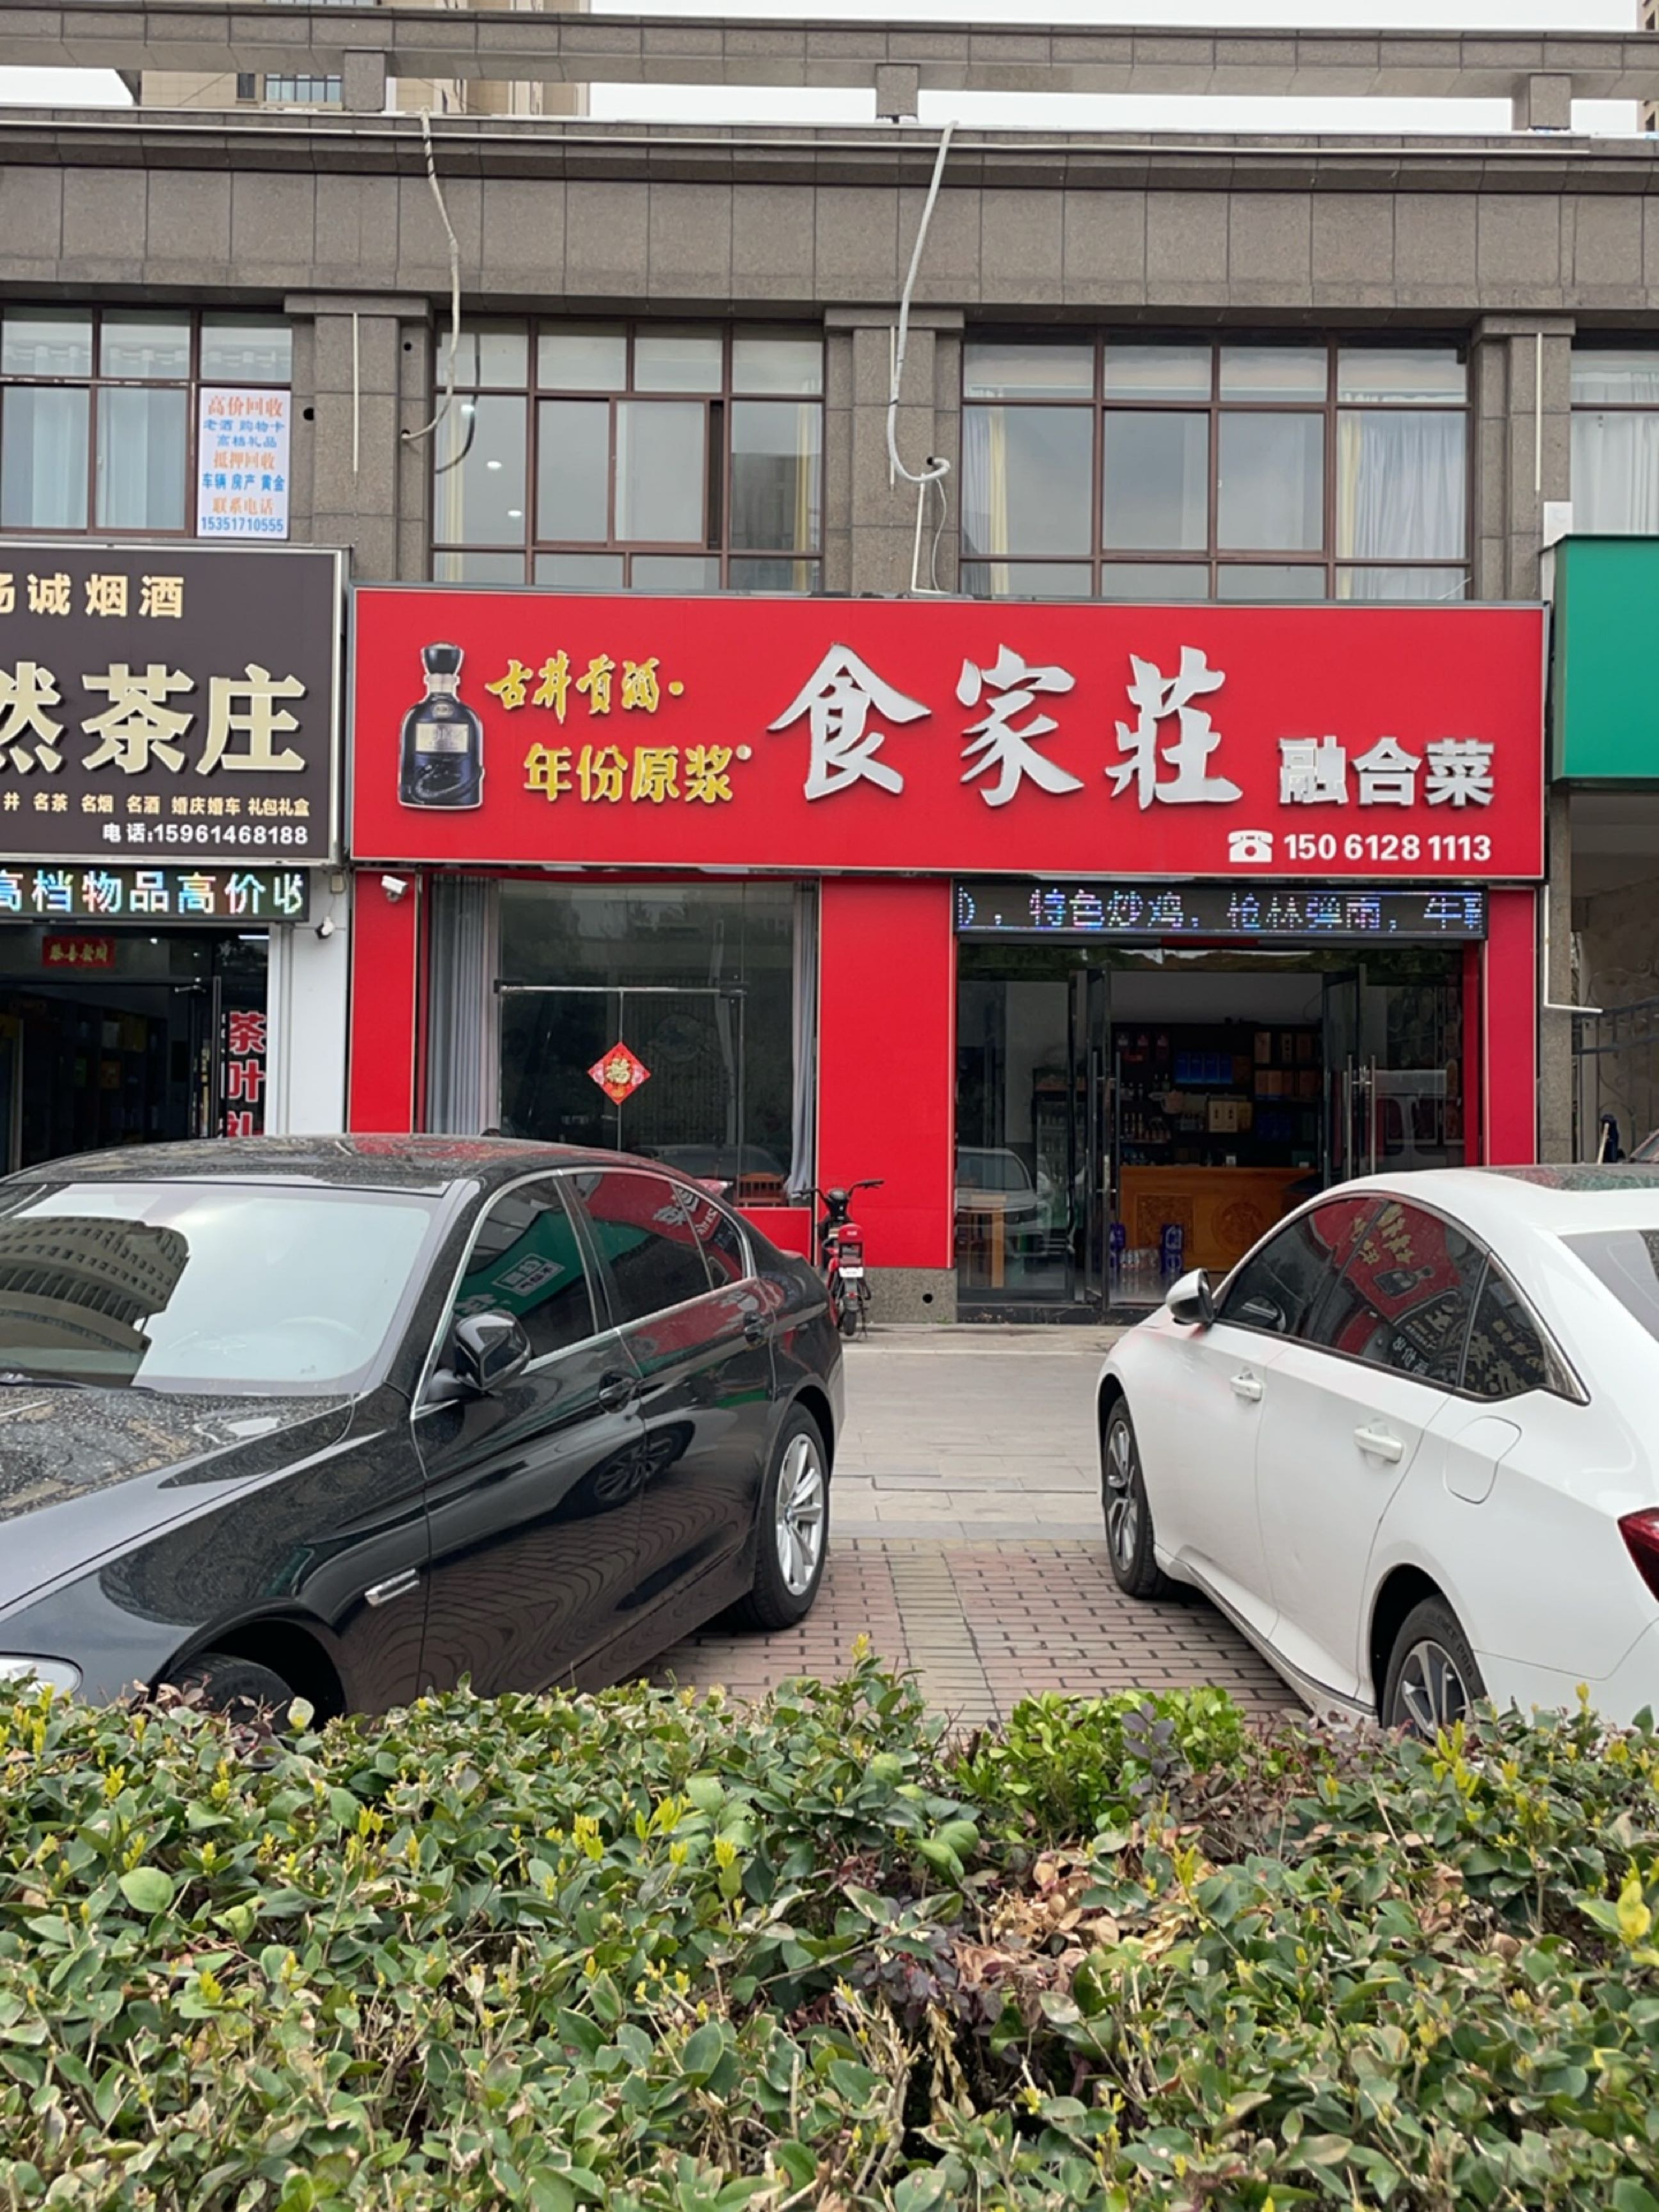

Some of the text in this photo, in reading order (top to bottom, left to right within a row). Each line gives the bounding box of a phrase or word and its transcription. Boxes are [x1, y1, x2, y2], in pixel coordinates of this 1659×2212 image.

[208, 396, 283, 417] 高价回收
[213, 450, 275, 470] 抵押回收
[202, 472, 285, 492] 车辆 房产 黄金
[212, 496, 273, 515] 联系电话
[202, 517, 284, 532] 15351710555
[524, 742, 732, 804] 年份原浆
[1278, 735, 1495, 807] 融合菜
[33, 792, 68, 813] 名茶
[81, 794, 115, 814] 名烟
[126, 795, 160, 815] 名酒
[171, 796, 241, 816] 婚庆婚车
[247, 797, 310, 817] 礼包礼盒
[1285, 834, 1491, 862] 150 6128 1113
